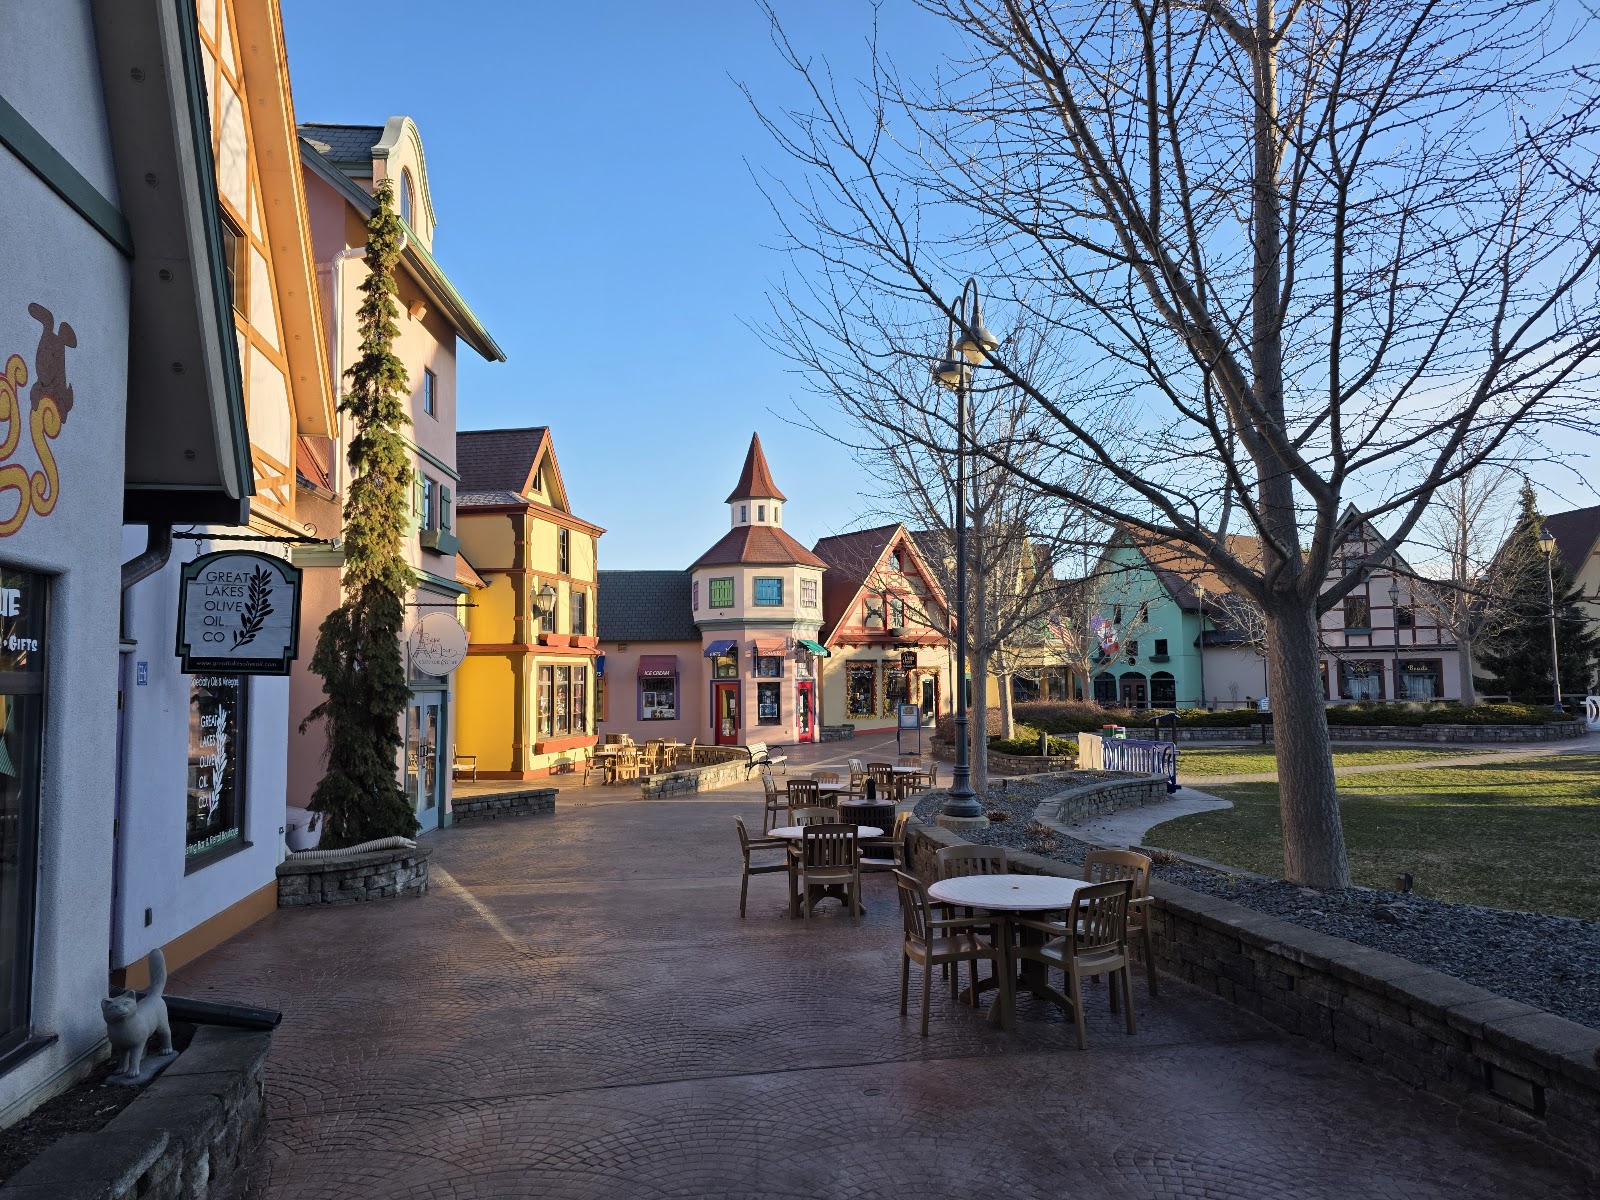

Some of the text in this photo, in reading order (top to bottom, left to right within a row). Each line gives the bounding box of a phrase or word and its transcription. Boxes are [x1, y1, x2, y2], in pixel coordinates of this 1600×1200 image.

[206, 571, 251, 583] GREAT
[205, 585, 244, 598] LAKES
[204, 600, 243, 612] OLIVE
[203, 615, 225, 627] OIL
[202, 631, 226, 643] CO
[200, 714, 218, 728] GREAT
[199, 734, 216, 748] LAKES
[199, 754, 215, 768] OLIVE
